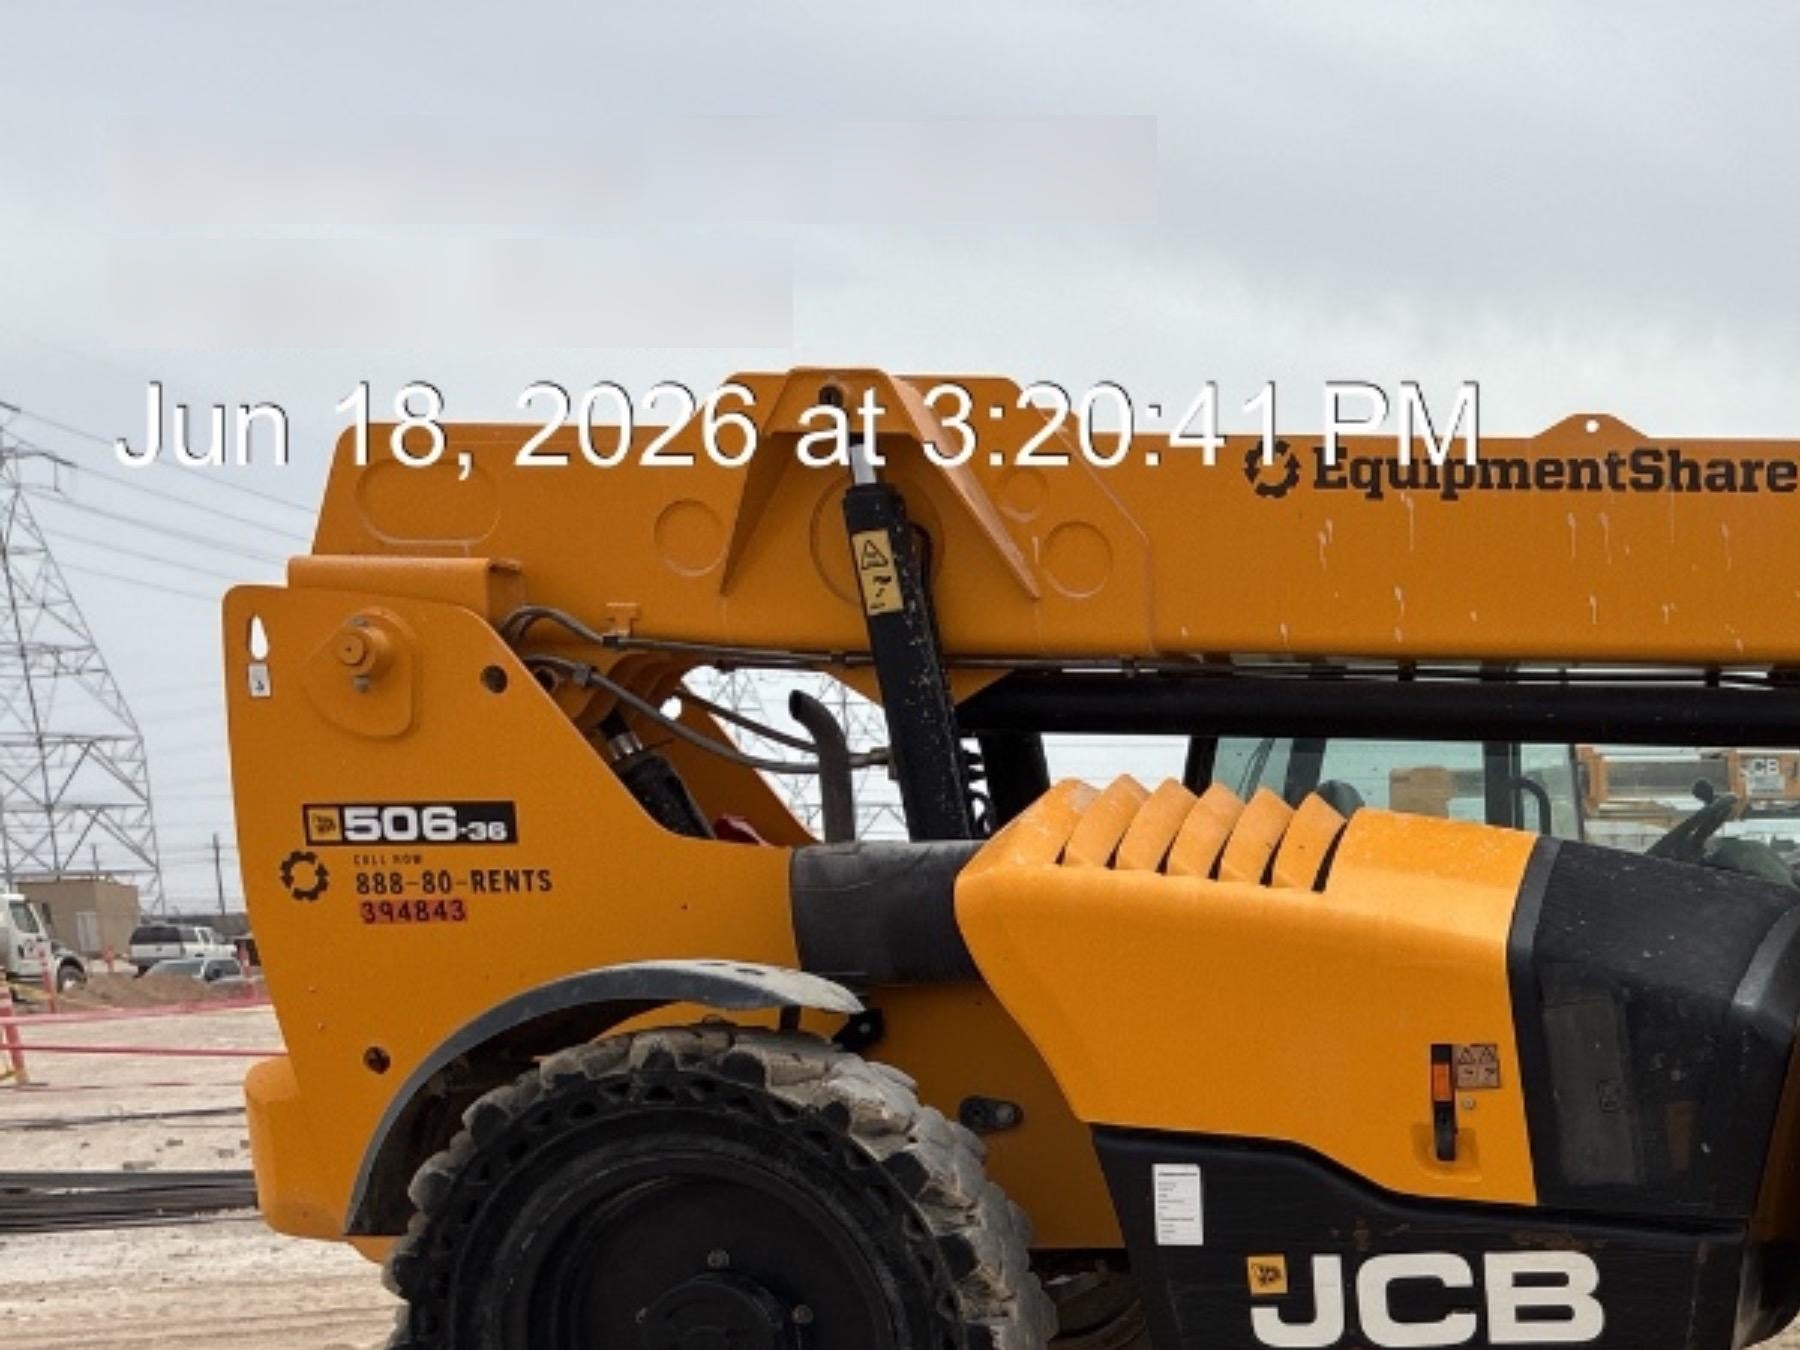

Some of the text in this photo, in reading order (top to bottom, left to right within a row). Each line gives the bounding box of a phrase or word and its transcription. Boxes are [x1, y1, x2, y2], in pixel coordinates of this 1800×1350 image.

[1312, 446, 1799, 501] EquipmentShare
[356, 869, 553, 895] 888-80-RENTS
[360, 899, 466, 924] 394843
[1250, 1251, 1606, 1348] JCB
